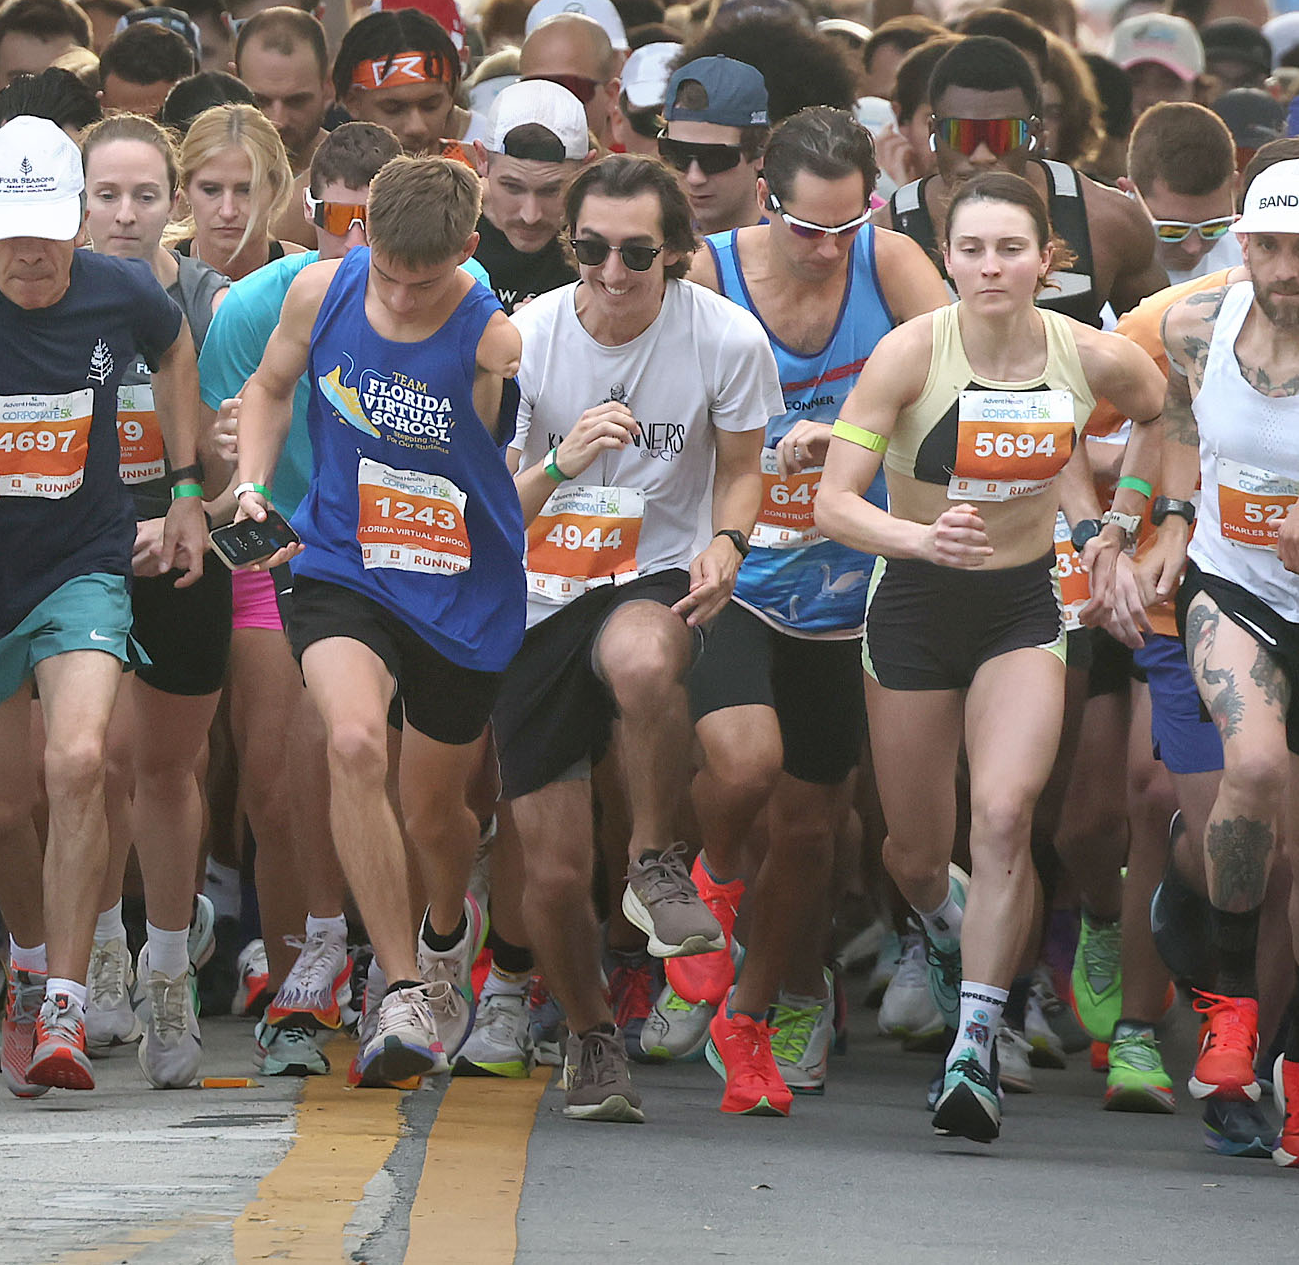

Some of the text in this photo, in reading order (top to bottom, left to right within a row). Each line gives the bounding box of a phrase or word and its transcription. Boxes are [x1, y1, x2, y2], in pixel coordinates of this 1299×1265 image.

[20, 176, 55, 184] SEASONS
[392, 370, 428, 395] TEAM
[367, 377, 452, 413] FLORIDA
[2, 408, 73, 421] CORPORATE 5k
[362, 392, 450, 429] VIRTUAL
[1037, 407, 1051, 419] 5k
[371, 410, 451, 443] SCHOOL
[974, 432, 1056, 458] 5694
[36, 477, 82, 493] RUNNER
[375, 496, 457, 531] 1243
[551, 502, 620, 515] CORPORATE 5k
[1244, 502, 1297, 524] 52
[359, 525, 468, 550] FLORIDA VIRTUAL SCHOOL
[545, 523, 622, 552] 4944
[1223, 522, 1265, 537] CHARLES
[414, 555, 466, 572] RUNNER
